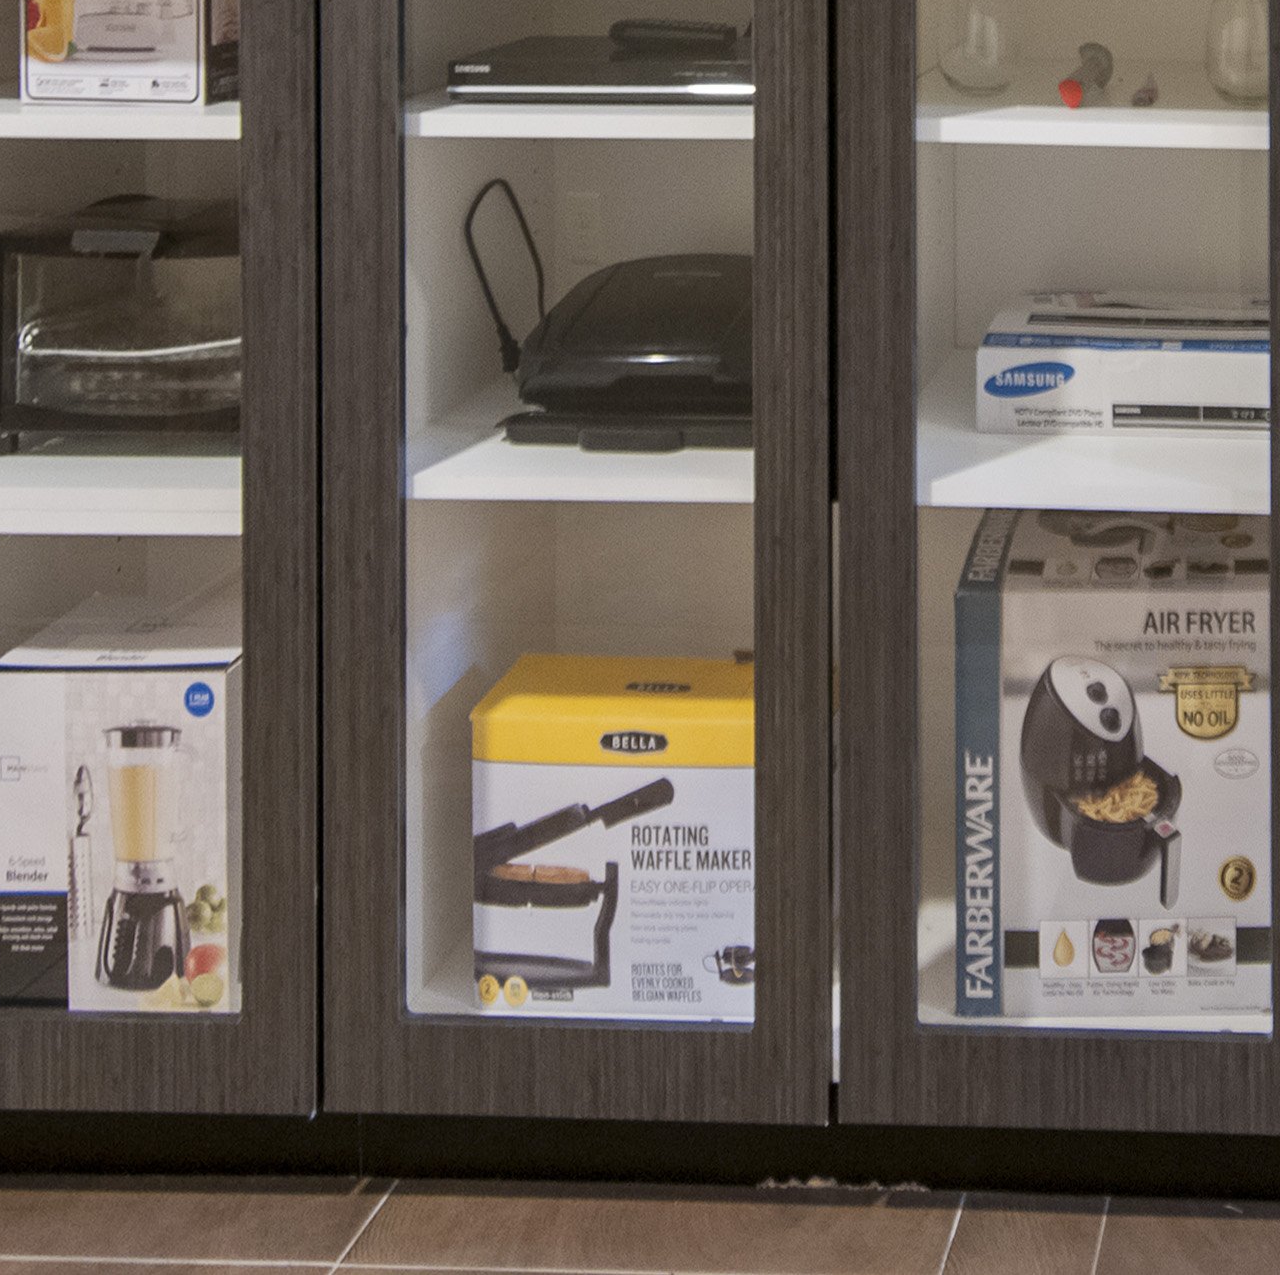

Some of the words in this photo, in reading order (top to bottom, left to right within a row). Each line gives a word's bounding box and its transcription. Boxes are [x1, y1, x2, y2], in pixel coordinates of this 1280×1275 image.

[994, 372, 1065, 388] SAMSUNG
[1143, 610, 1180, 635] AIR
[1186, 610, 1256, 635] FRYER
[1094, 640, 1113, 652] The
[1144, 641, 1155, 652] to
[1157, 639, 1193, 653] healthy
[1228, 639, 1257, 654] frying
[1180, 689, 1203, 700] USES
[1205, 689, 1235, 700] LITTLE
[1183, 710, 1204, 727] NO
[1207, 710, 1231, 727] OIL
[611, 735, 657, 750] BELLA
[631, 824, 709, 846] ROTATING
[630, 849, 692, 871] WAFFLE
[696, 849, 752, 871] MAKER
[6, 870, 49, 882] Blender
[964, 750, 995, 1001] FARBERWARE
[1230, 867, 1245, 886] 2
[630, 880, 661, 894] EASY
[663, 880, 717, 894] ONE-FLIP
[631, 963, 664, 975] ROTATES
[666, 963, 683, 975] FOR
[631, 977, 661, 990] EVENLY
[662, 977, 694, 990] COOKED
[632, 990, 665, 1002] BELGIAN
[666, 990, 702, 1003] WAFFLES
